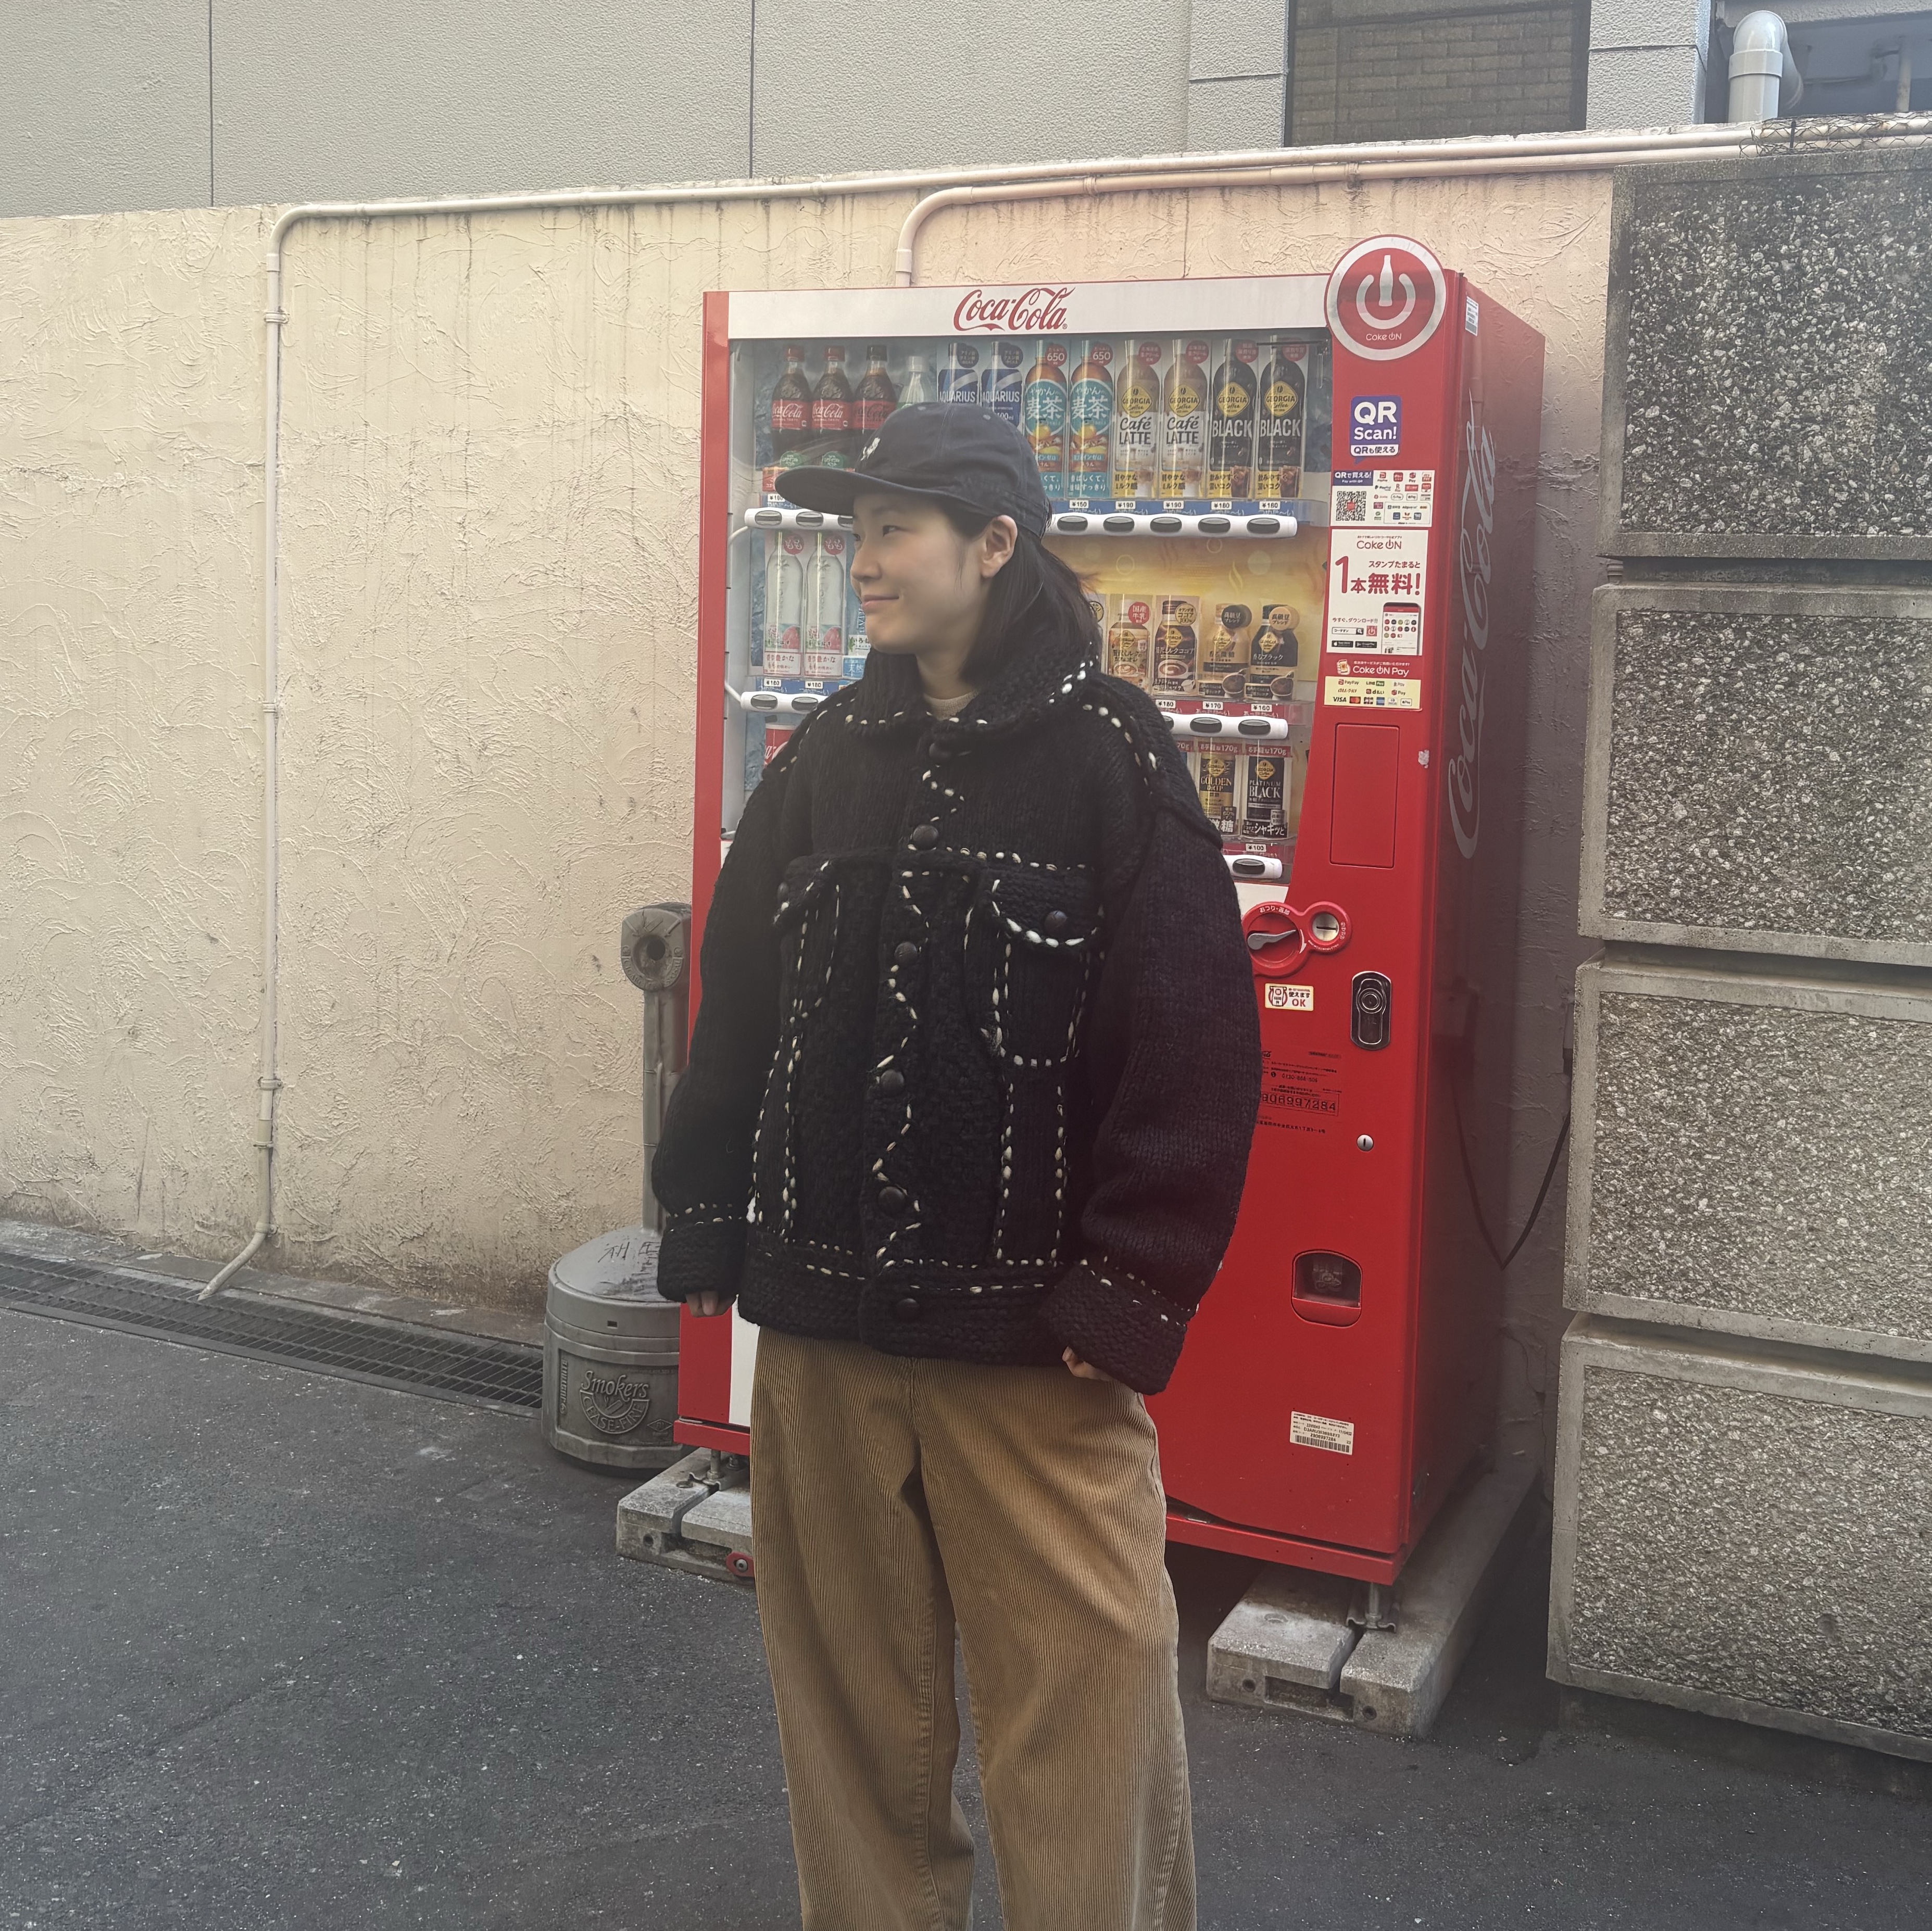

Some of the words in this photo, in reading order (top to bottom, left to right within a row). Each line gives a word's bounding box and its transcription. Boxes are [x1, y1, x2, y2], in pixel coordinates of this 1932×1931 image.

[954, 287, 1075, 332] Coca-Cola
[939, 392, 975, 402] AQUARIUS
[983, 391, 1020, 402] AQUARIUS
[812, 403, 844, 418] Coca-Cola
[1026, 396, 1064, 420] 麦茶
[1072, 395, 1110, 420] 麦茶
[1354, 401, 1397, 424] QR
[1120, 417, 1151, 431] Café
[1168, 415, 1199, 431] Café
[1212, 420, 1252, 438] BLACK
[1260, 419, 1301, 437] BLACK
[1119, 432, 1151, 445] LATTE
[1166, 431, 1199, 444] LATTE
[1354, 427, 1397, 440] Scan!
[785, 539, 802, 550] もも
[825, 539, 843, 550] もも
[1357, 540, 1383, 549] Coke
[1386, 539, 1401, 549] ON
[1335, 556, 1420, 595] 1本無料!
[1448, 387, 1496, 859] Coca-Cola
[1376, 666, 1390, 675] ON
[1392, 667, 1409, 677] Pay
[1201, 777, 1231, 786] GOLDEN
[1249, 786, 1281, 798] BLACK
[1255, 823, 1284, 835] シャキッと
[1292, 999, 1306, 1007] OK
[581, 1370, 648, 1402] Smokers
[583, 1396, 646, 1431] CEASE-FIRE
